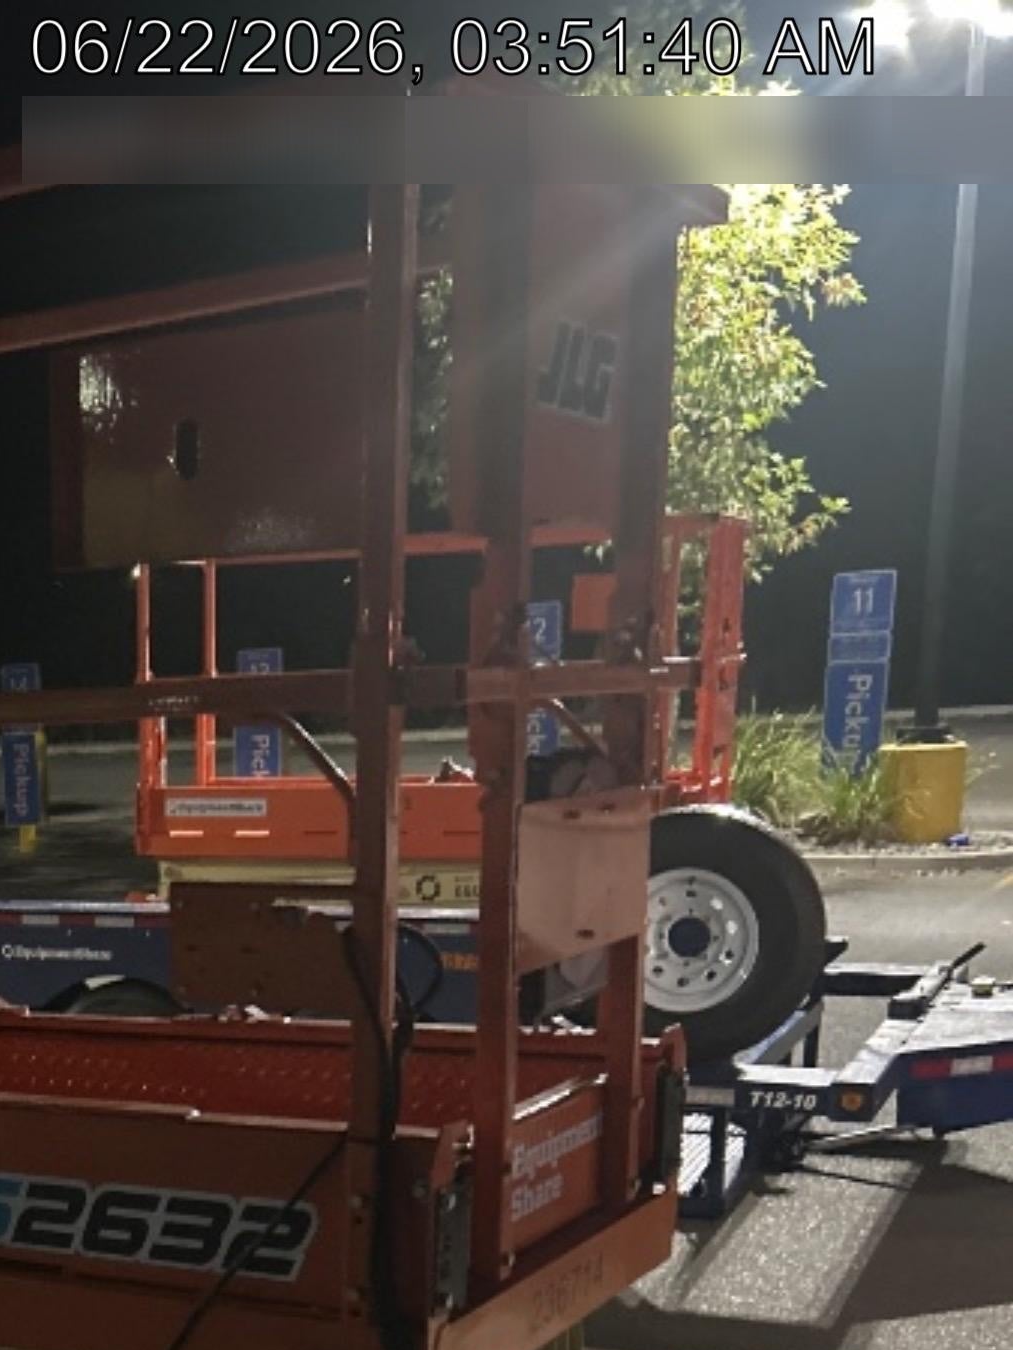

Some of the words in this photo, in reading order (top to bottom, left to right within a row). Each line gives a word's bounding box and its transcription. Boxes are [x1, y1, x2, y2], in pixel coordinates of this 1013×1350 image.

[537, 322, 617, 420] JLG
[851, 586, 875, 616] 11
[842, 673, 873, 750] Picku
[14, 743, 32, 817] Pickup
[750, 1090, 818, 1111] T12-10
[512, 1173, 563, 1222] Share
